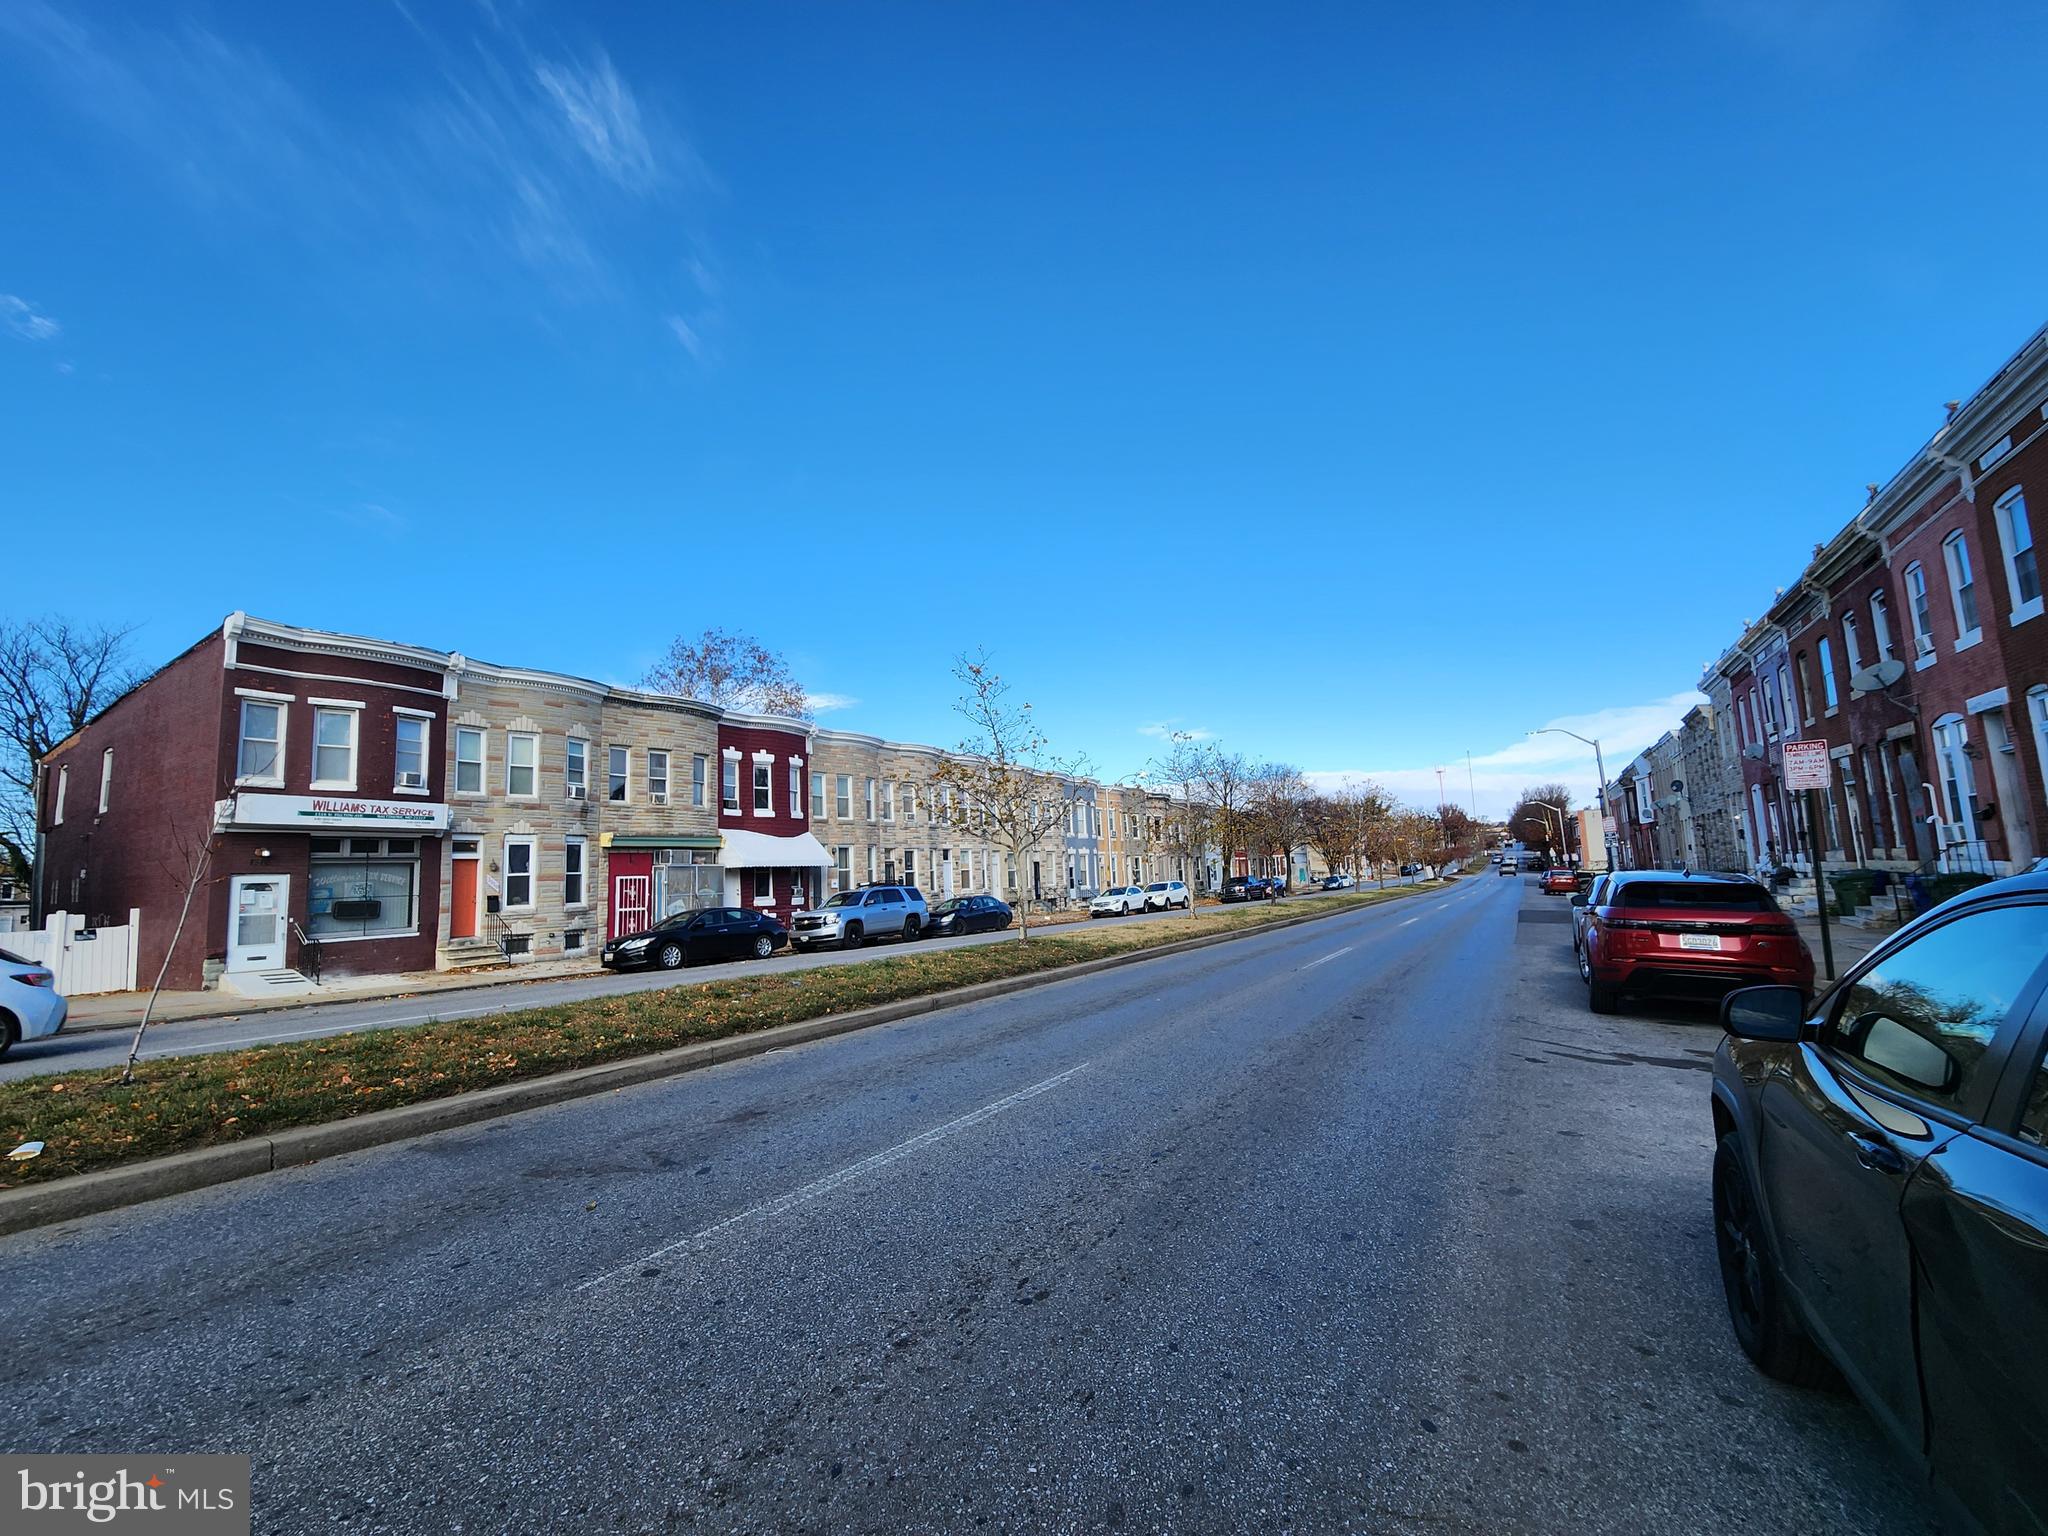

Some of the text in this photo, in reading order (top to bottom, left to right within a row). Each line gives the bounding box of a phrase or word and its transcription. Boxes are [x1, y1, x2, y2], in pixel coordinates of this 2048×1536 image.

[1786, 742, 1824, 752] PARKING
[313, 800, 434, 816] WILLIAMS TAX SERVICE
